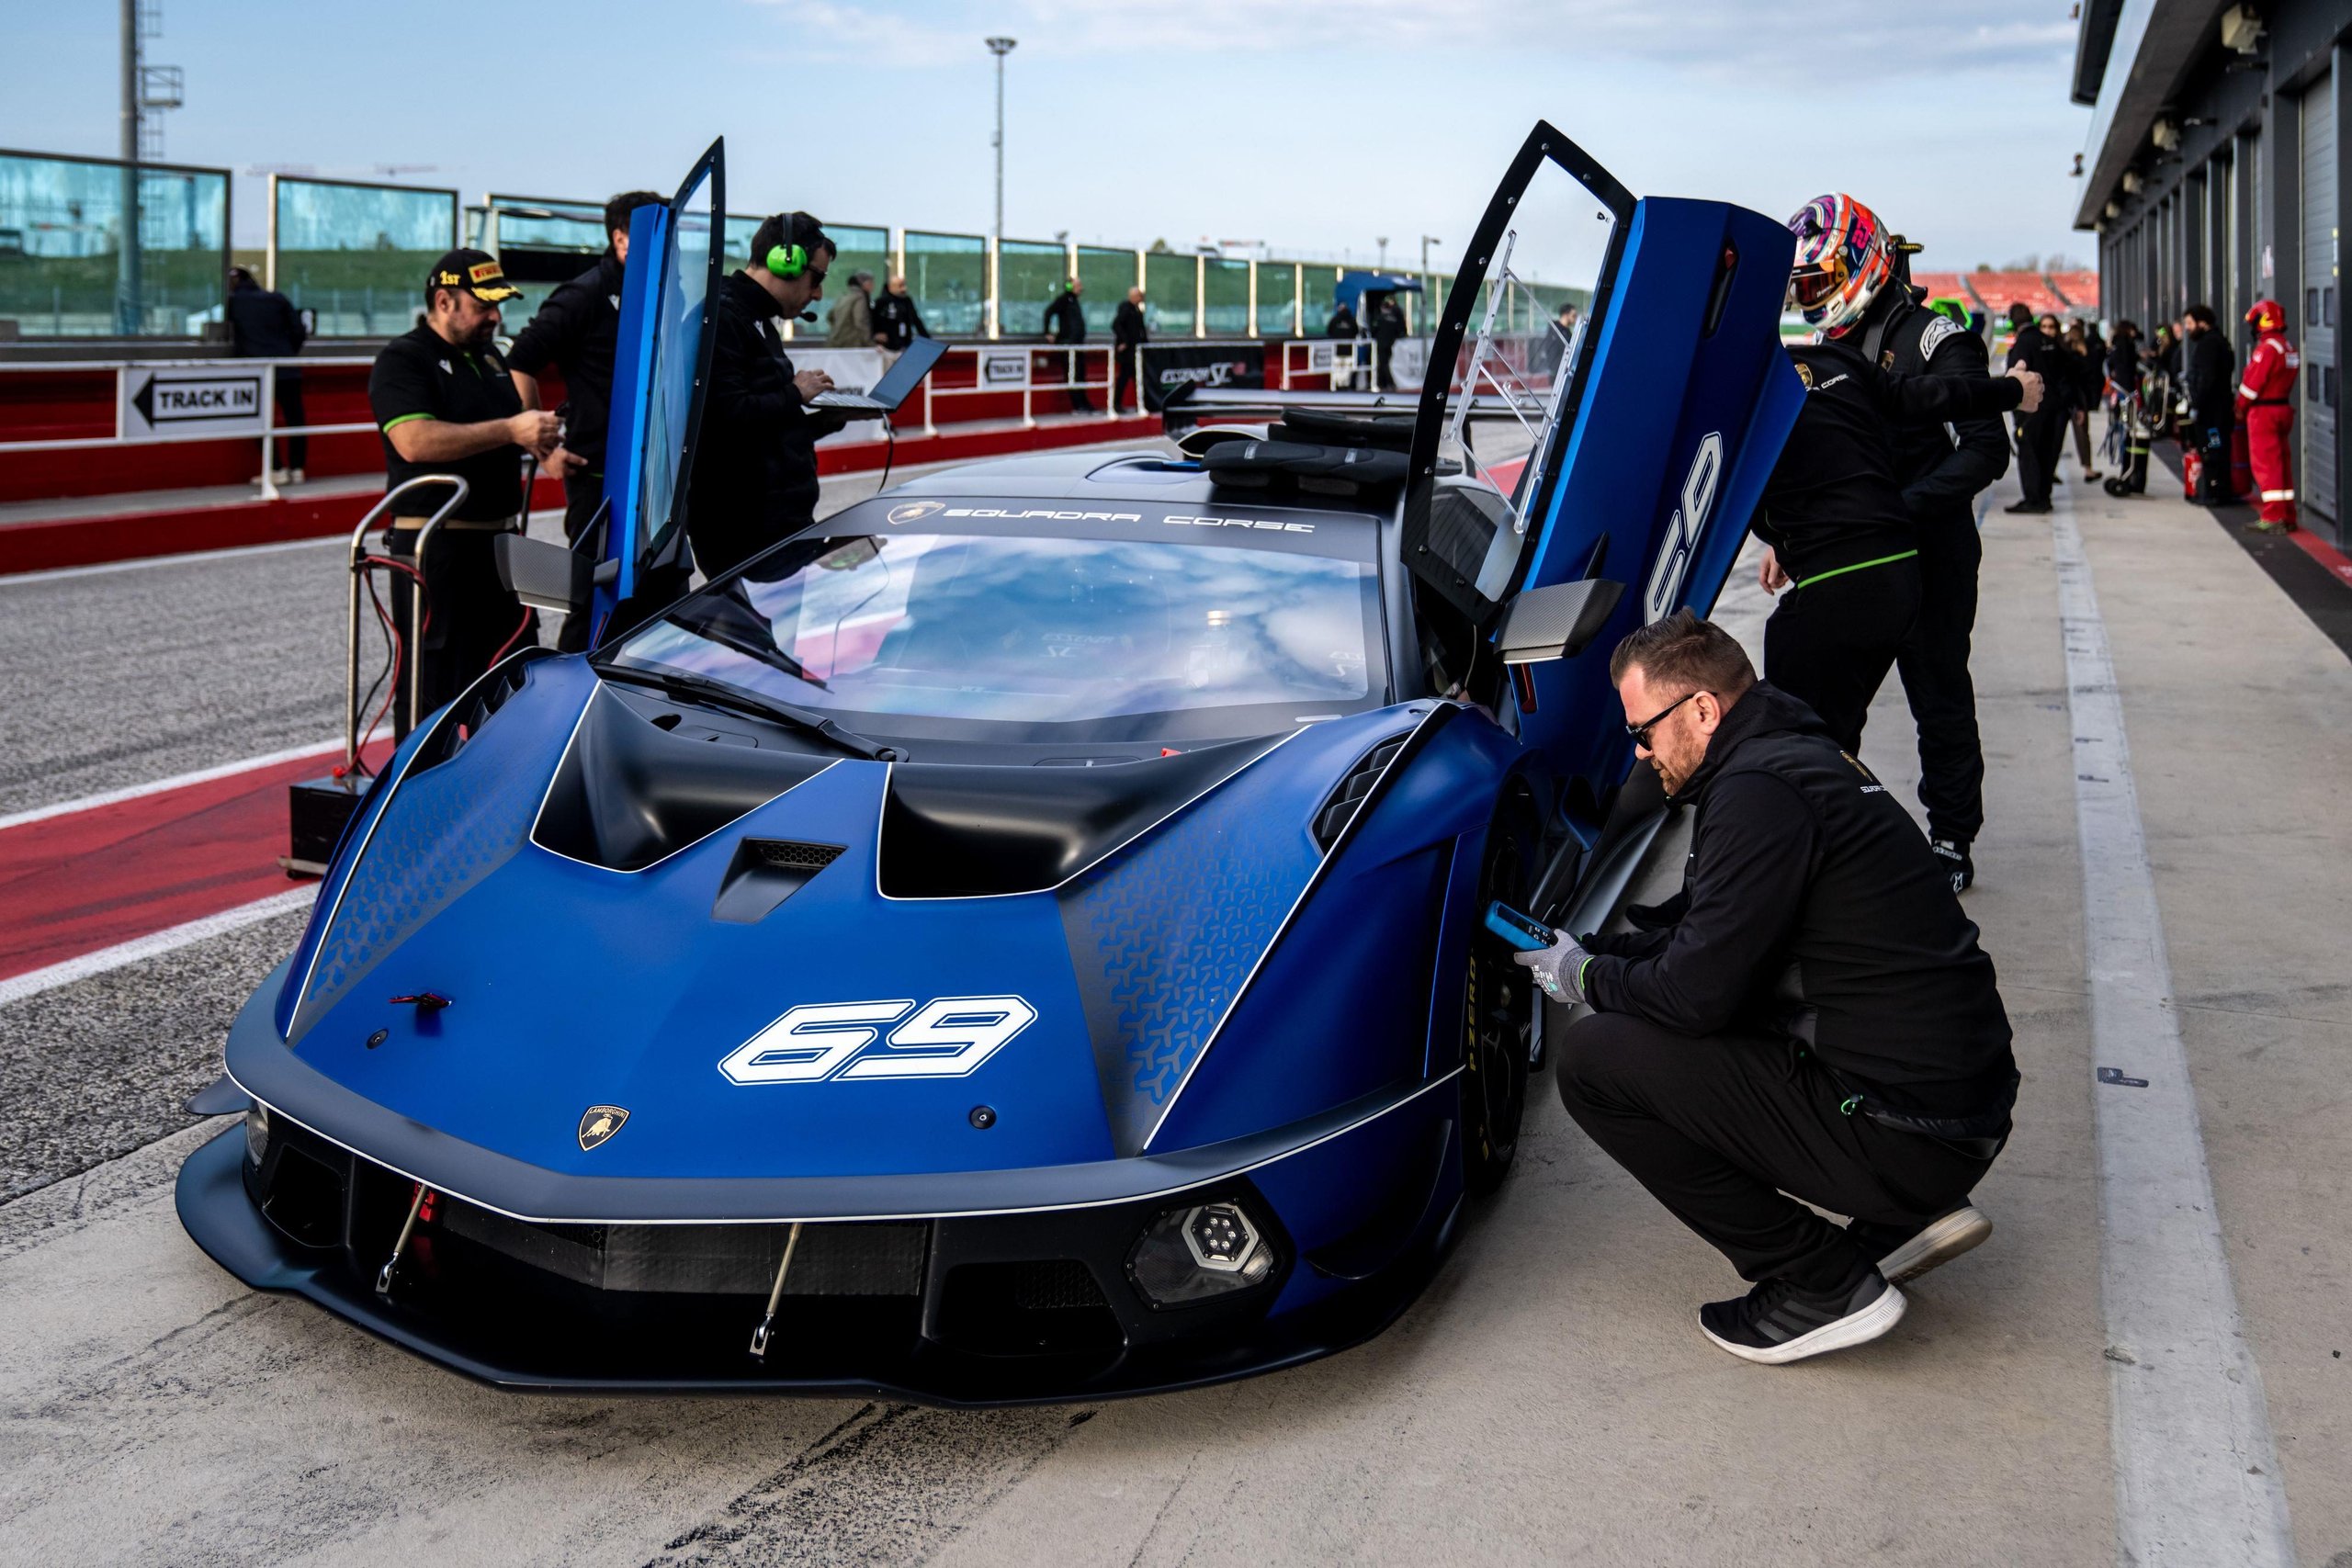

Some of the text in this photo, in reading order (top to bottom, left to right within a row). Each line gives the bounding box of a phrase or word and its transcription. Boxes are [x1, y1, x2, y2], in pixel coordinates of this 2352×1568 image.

[159, 388, 254, 409] TRACK IN
[943, 508, 1315, 534] SQUADRA CORSE
[717, 988, 1039, 1087] 69
[588, 1107, 627, 1119] LAMBORGHINI
